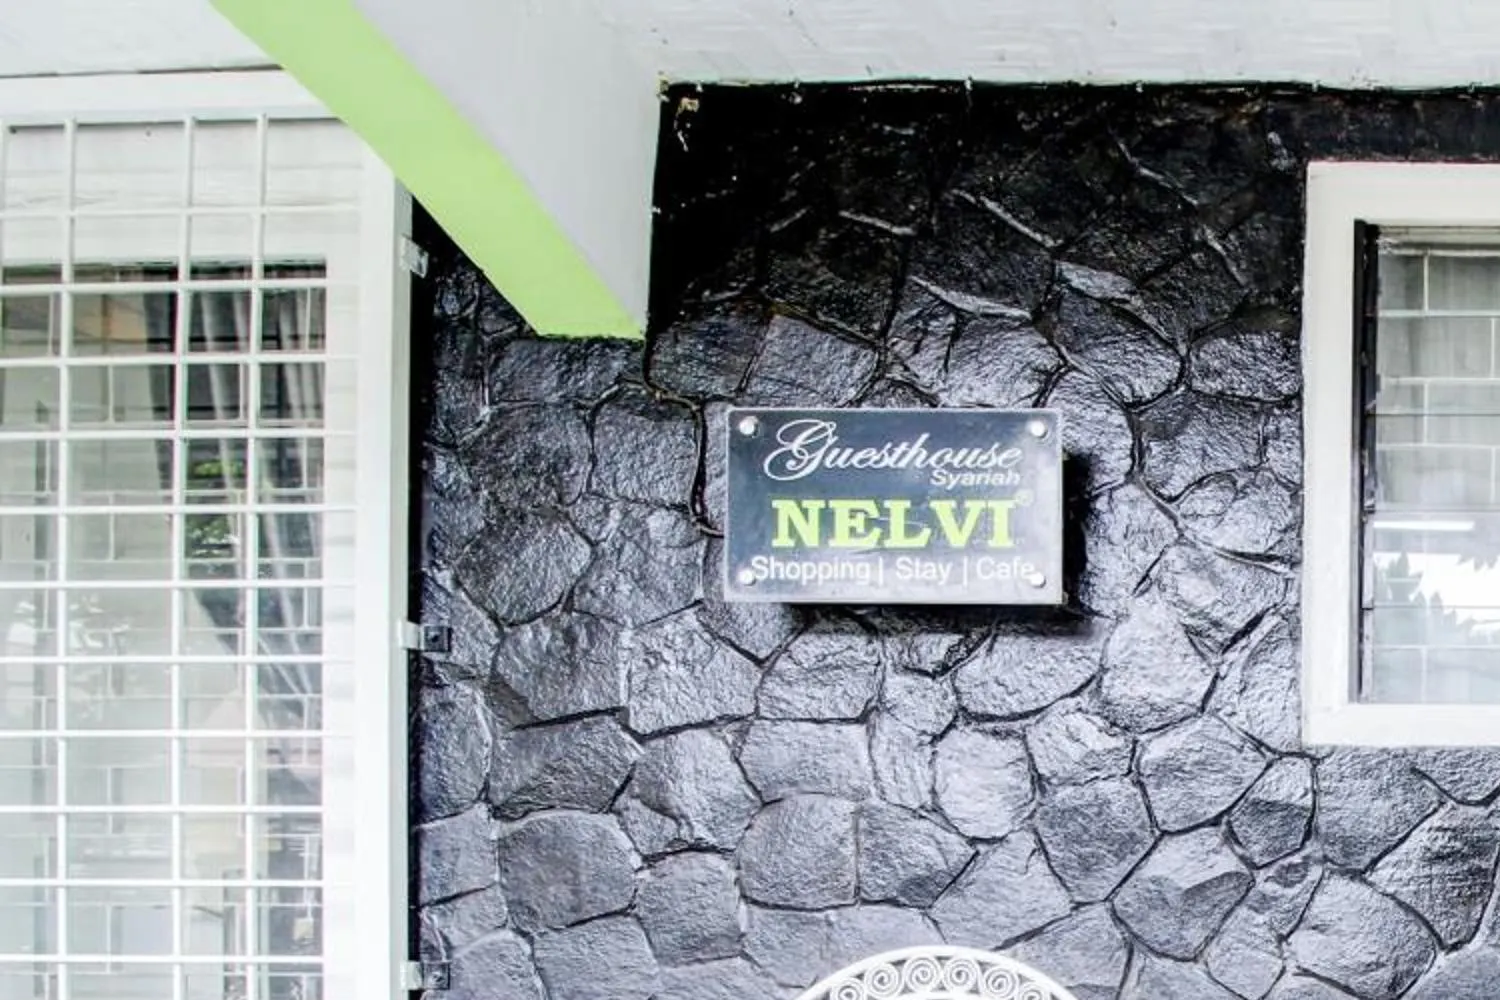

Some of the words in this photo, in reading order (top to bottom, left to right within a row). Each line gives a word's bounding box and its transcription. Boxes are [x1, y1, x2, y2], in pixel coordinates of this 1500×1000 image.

[763, 418, 1023, 481] Guesthouse
[930, 469, 1021, 490] Syariah
[771, 500, 1016, 548] NELVI
[751, 555, 871, 586] Shopping
[895, 555, 953, 586] Stay
[976, 555, 1035, 581] Cafe
